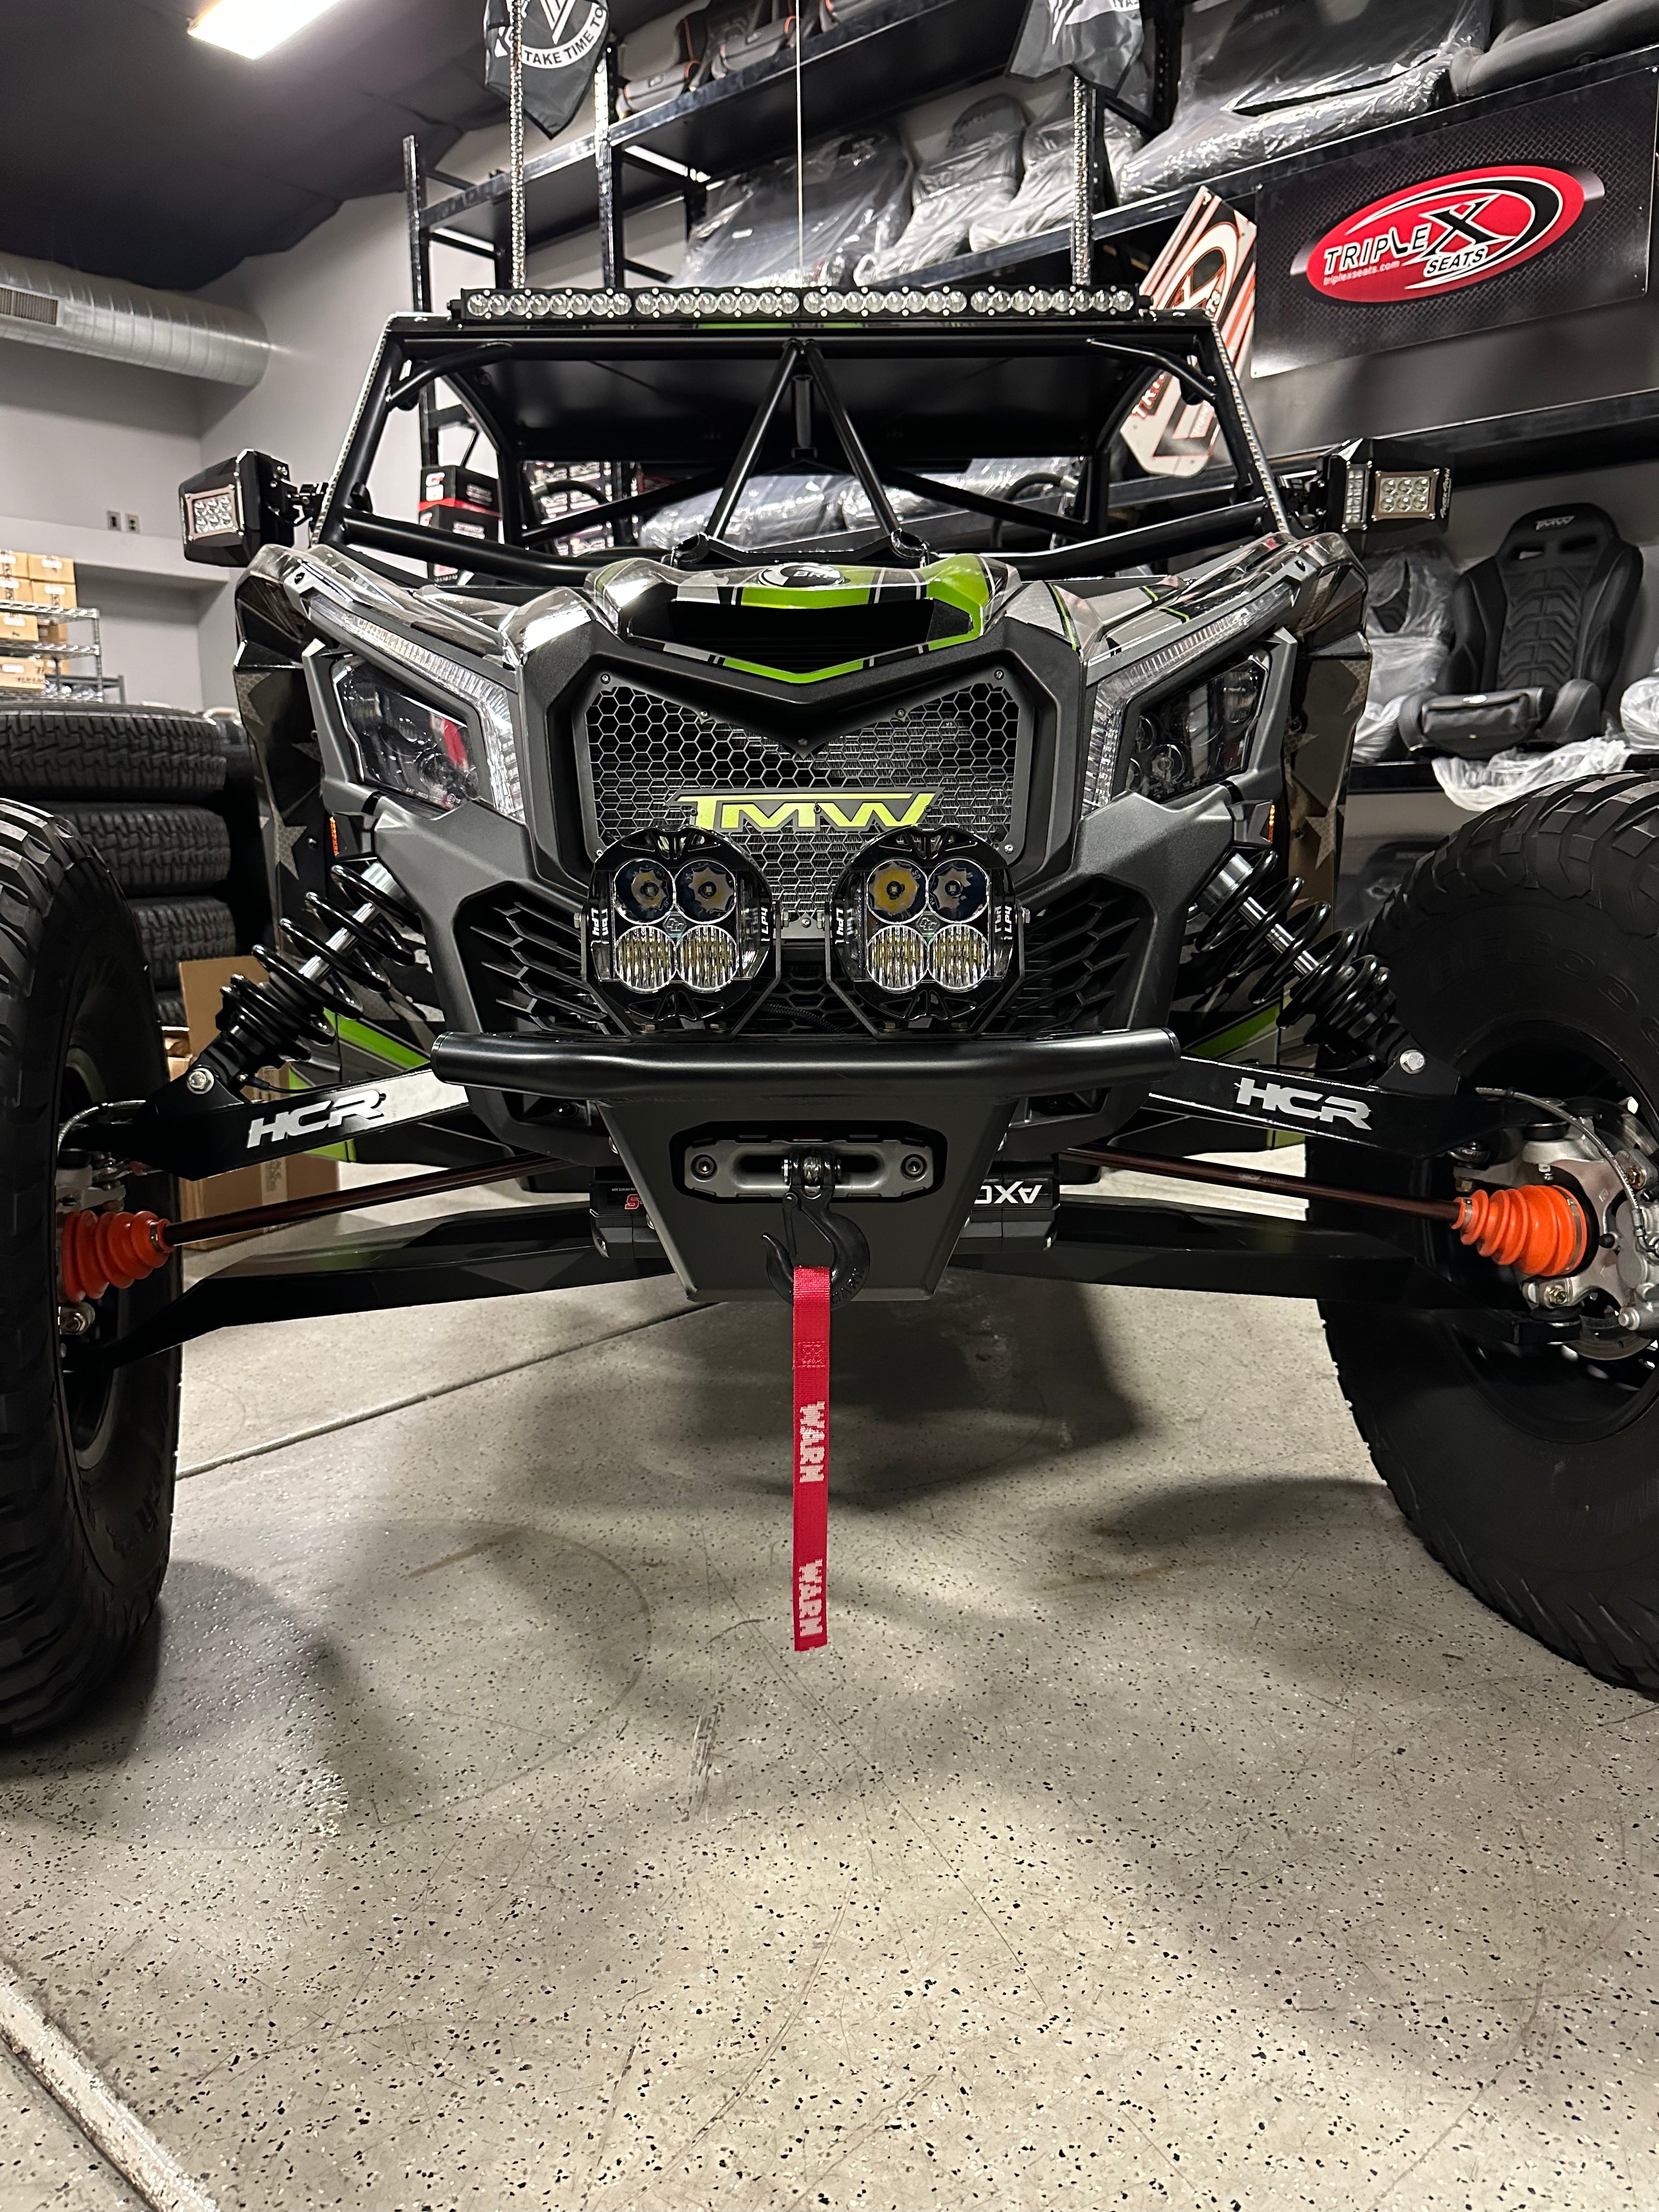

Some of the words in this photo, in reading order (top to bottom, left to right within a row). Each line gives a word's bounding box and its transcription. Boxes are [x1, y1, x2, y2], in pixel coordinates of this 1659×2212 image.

[524, 50, 562, 65] TAKE
[563, 31, 594, 59] TIME
[590, 8, 604, 27] TO
[1323, 193, 1515, 275] TRIPLEX
[1323, 260, 1401, 286] triplexseats.com
[1425, 246, 1487, 276] SEATS
[675, 793, 935, 830] TMW
[760, 906, 769, 935] LP4
[836, 907, 844, 936] LP4
[1005, 905, 1013, 933] LP4
[247, 1090, 384, 1149] HCR
[1236, 1077, 1372, 1131] HCR
[799, 1401, 825, 1483] WARN
[799, 1558, 823, 1637] WARN
